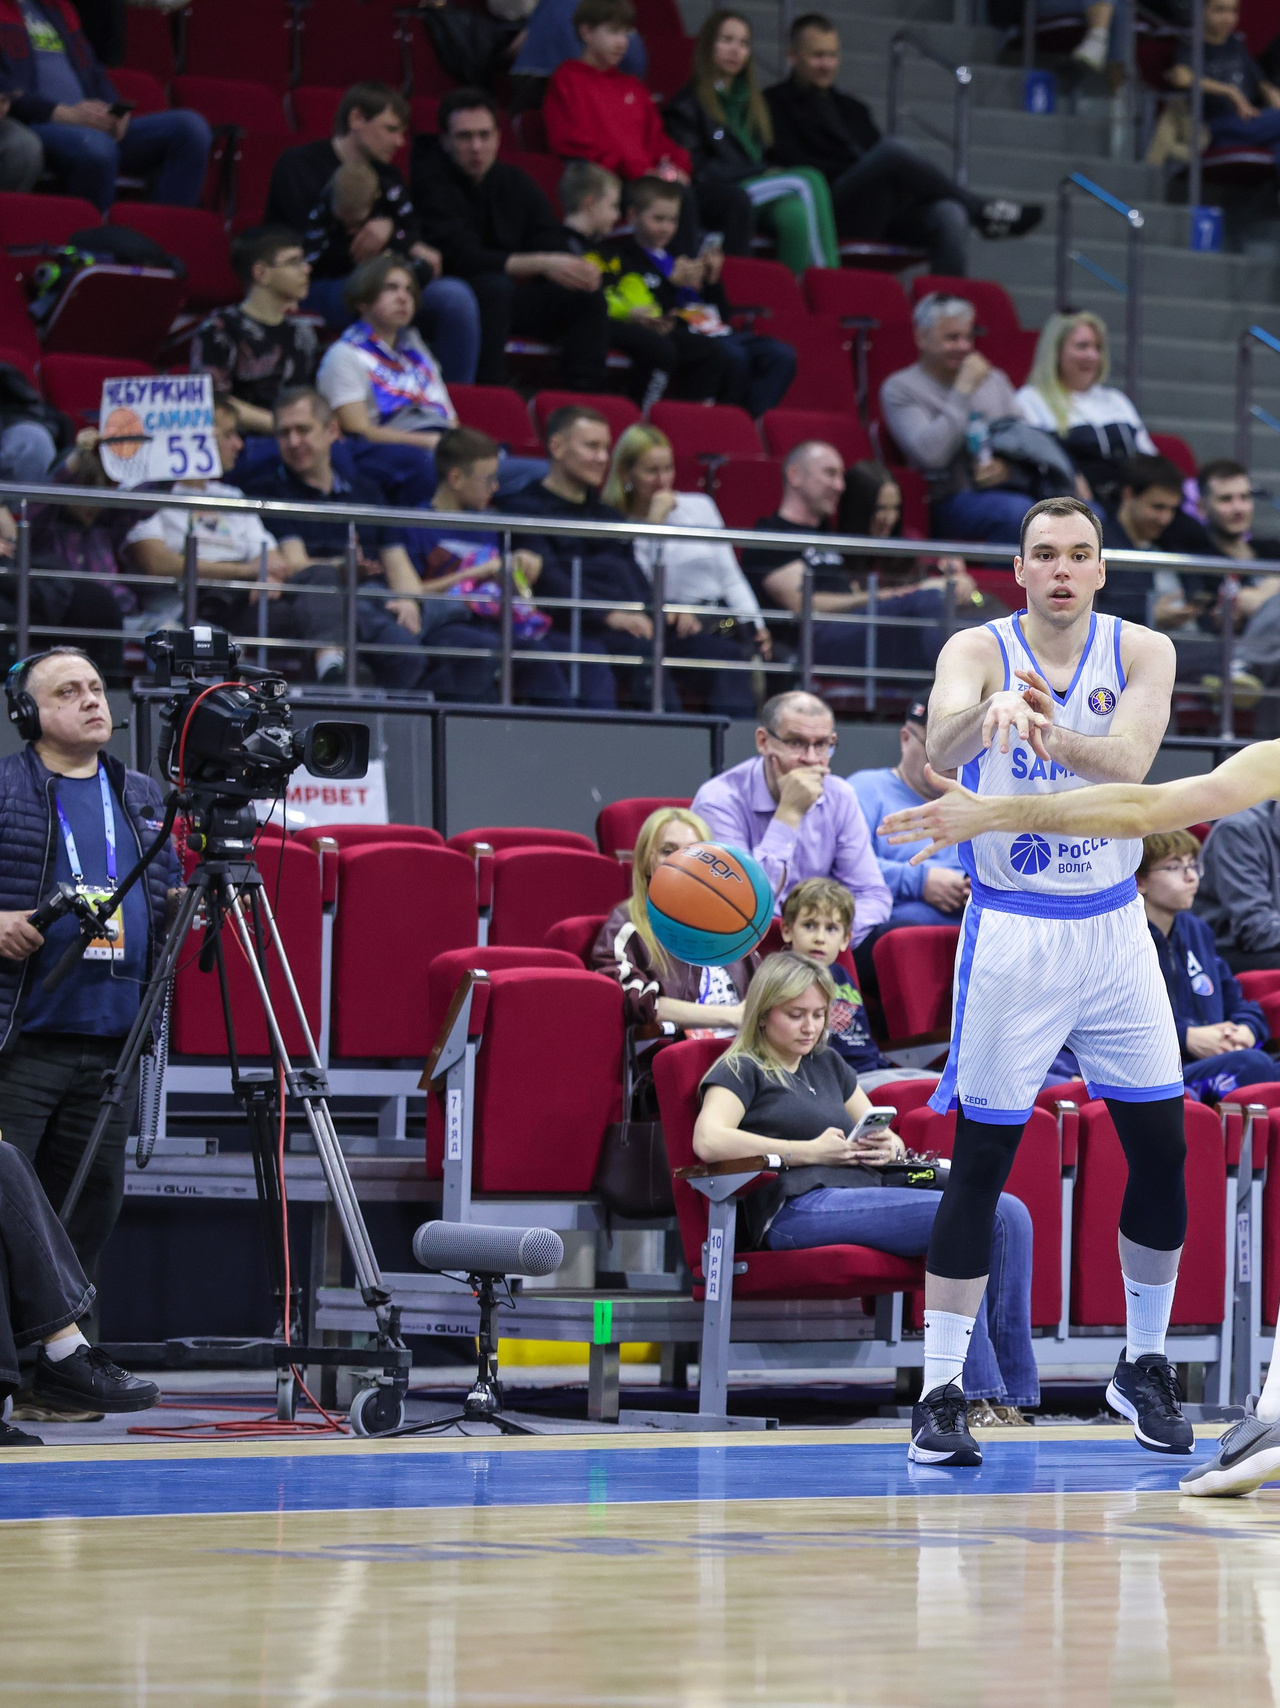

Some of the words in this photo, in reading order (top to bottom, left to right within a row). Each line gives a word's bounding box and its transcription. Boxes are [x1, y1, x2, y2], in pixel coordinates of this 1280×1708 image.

[167, 434, 214, 475] 53
[1058, 861, 1093, 874] ВОЛГА
[451, 1096, 458, 1109] 7
[964, 1095, 988, 1106] ZEDO
[164, 1184, 204, 1195] GUIL
[711, 1235, 722, 1249] 10
[709, 1257, 718, 1294] РЯД
[434, 1323, 476, 1334] GUIL
